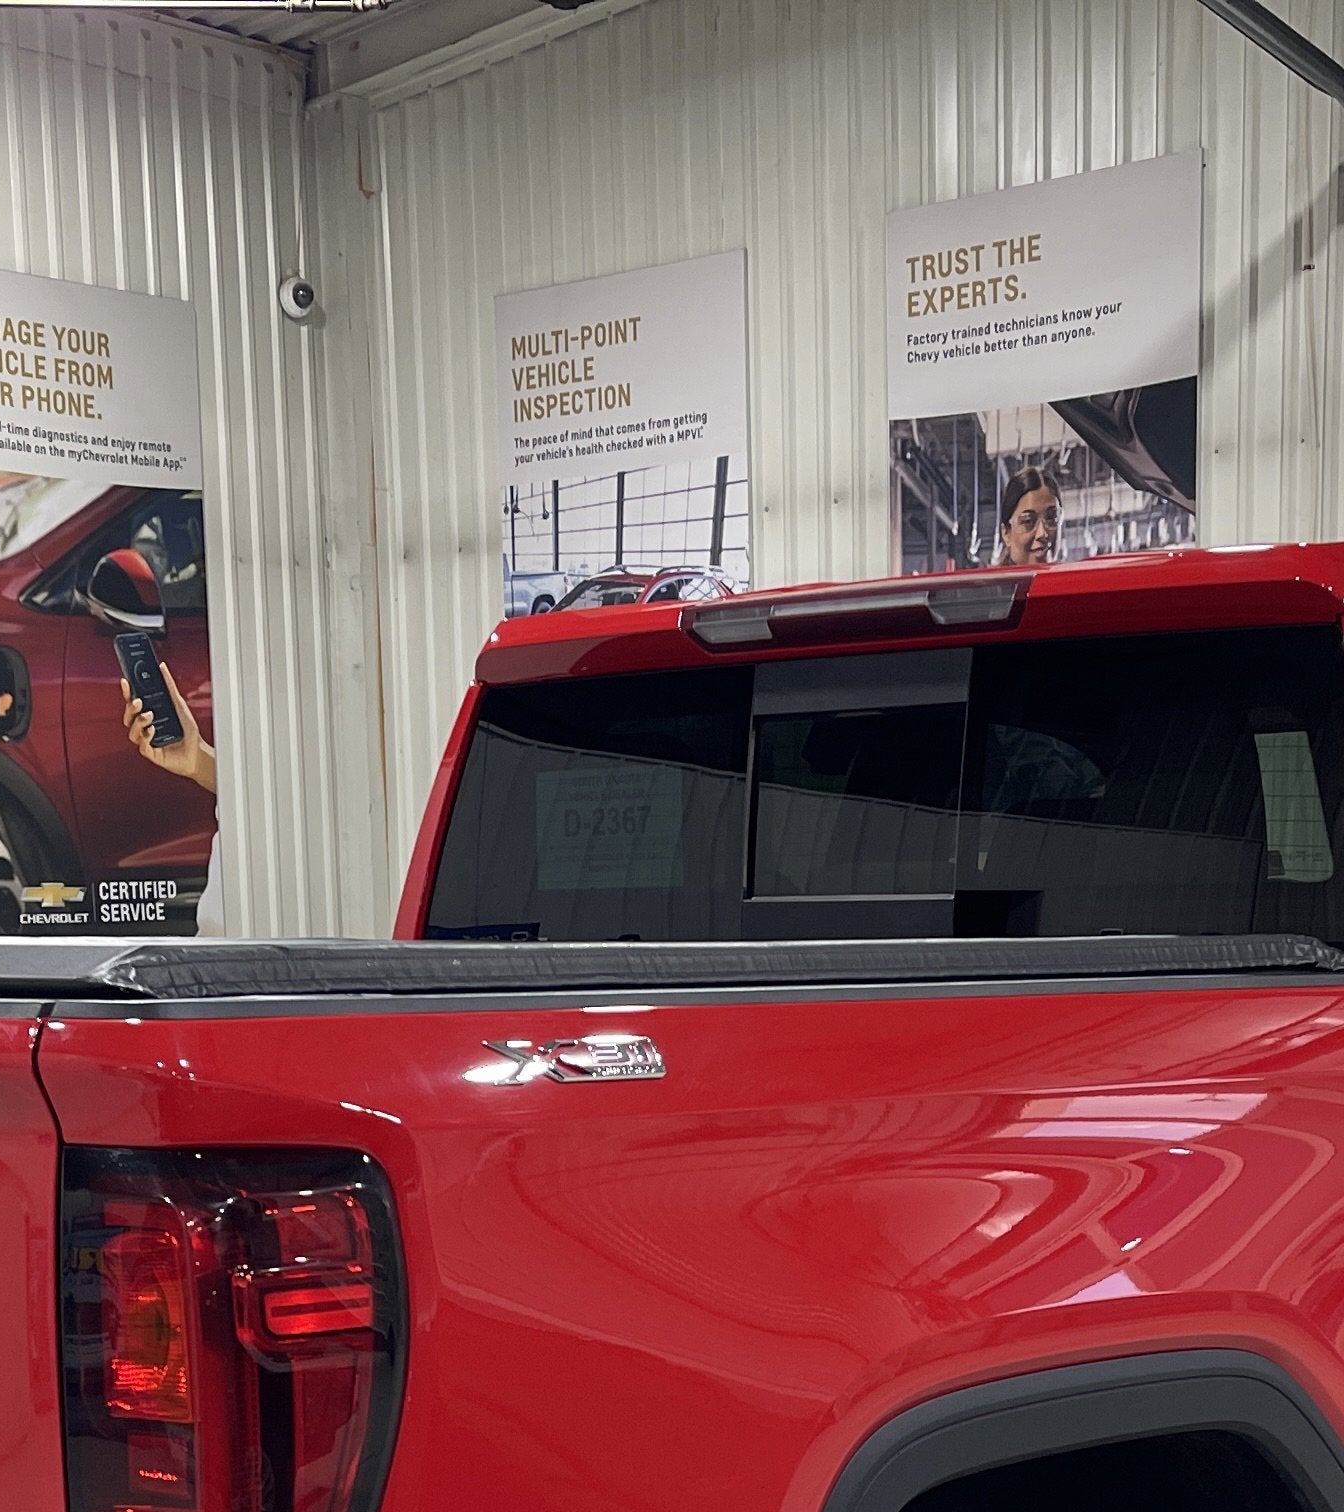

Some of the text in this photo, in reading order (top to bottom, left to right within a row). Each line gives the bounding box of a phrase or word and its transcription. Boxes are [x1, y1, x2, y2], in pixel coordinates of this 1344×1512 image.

[906, 234, 1042, 284] TRUST THE
[907, 274, 1026, 318] EXPERTS.
[52, 324, 111, 358] YOUR
[512, 316, 640, 360] MULTI-POINT
[906, 302, 1122, 346] Factory trained technicians know your
[906, 326, 1096, 364] Chevy vehicle better than anyone.
[54, 357, 114, 390] FROM
[512, 357, 594, 392] VEHICLE
[21, 384, 103, 420] PHONE.
[514, 383, 631, 422] INSPECTION
[32, 425, 88, 444] diagnostics
[90, 434, 108, 447] and
[110, 438, 136, 453] enjoy
[138, 440, 172, 452] remote
[514, 413, 708, 449] The peace of mind that comes from getting
[34, 444, 46, 455] on
[48, 443, 65, 457] the
[68, 448, 128, 465] myChevrolet
[130, 453, 160, 467] Mobile
[514, 453, 534, 469] your
[575, 440, 604, 456] health
[606, 436, 643, 451] checked
[646, 432, 666, 447] with
[669, 433, 674, 443] a
[564, 805, 651, 837] D-2367
[99, 880, 177, 900] CERTIFIED
[19, 913, 89, 924] CHEVROLET
[100, 902, 166, 922] SERVICE
